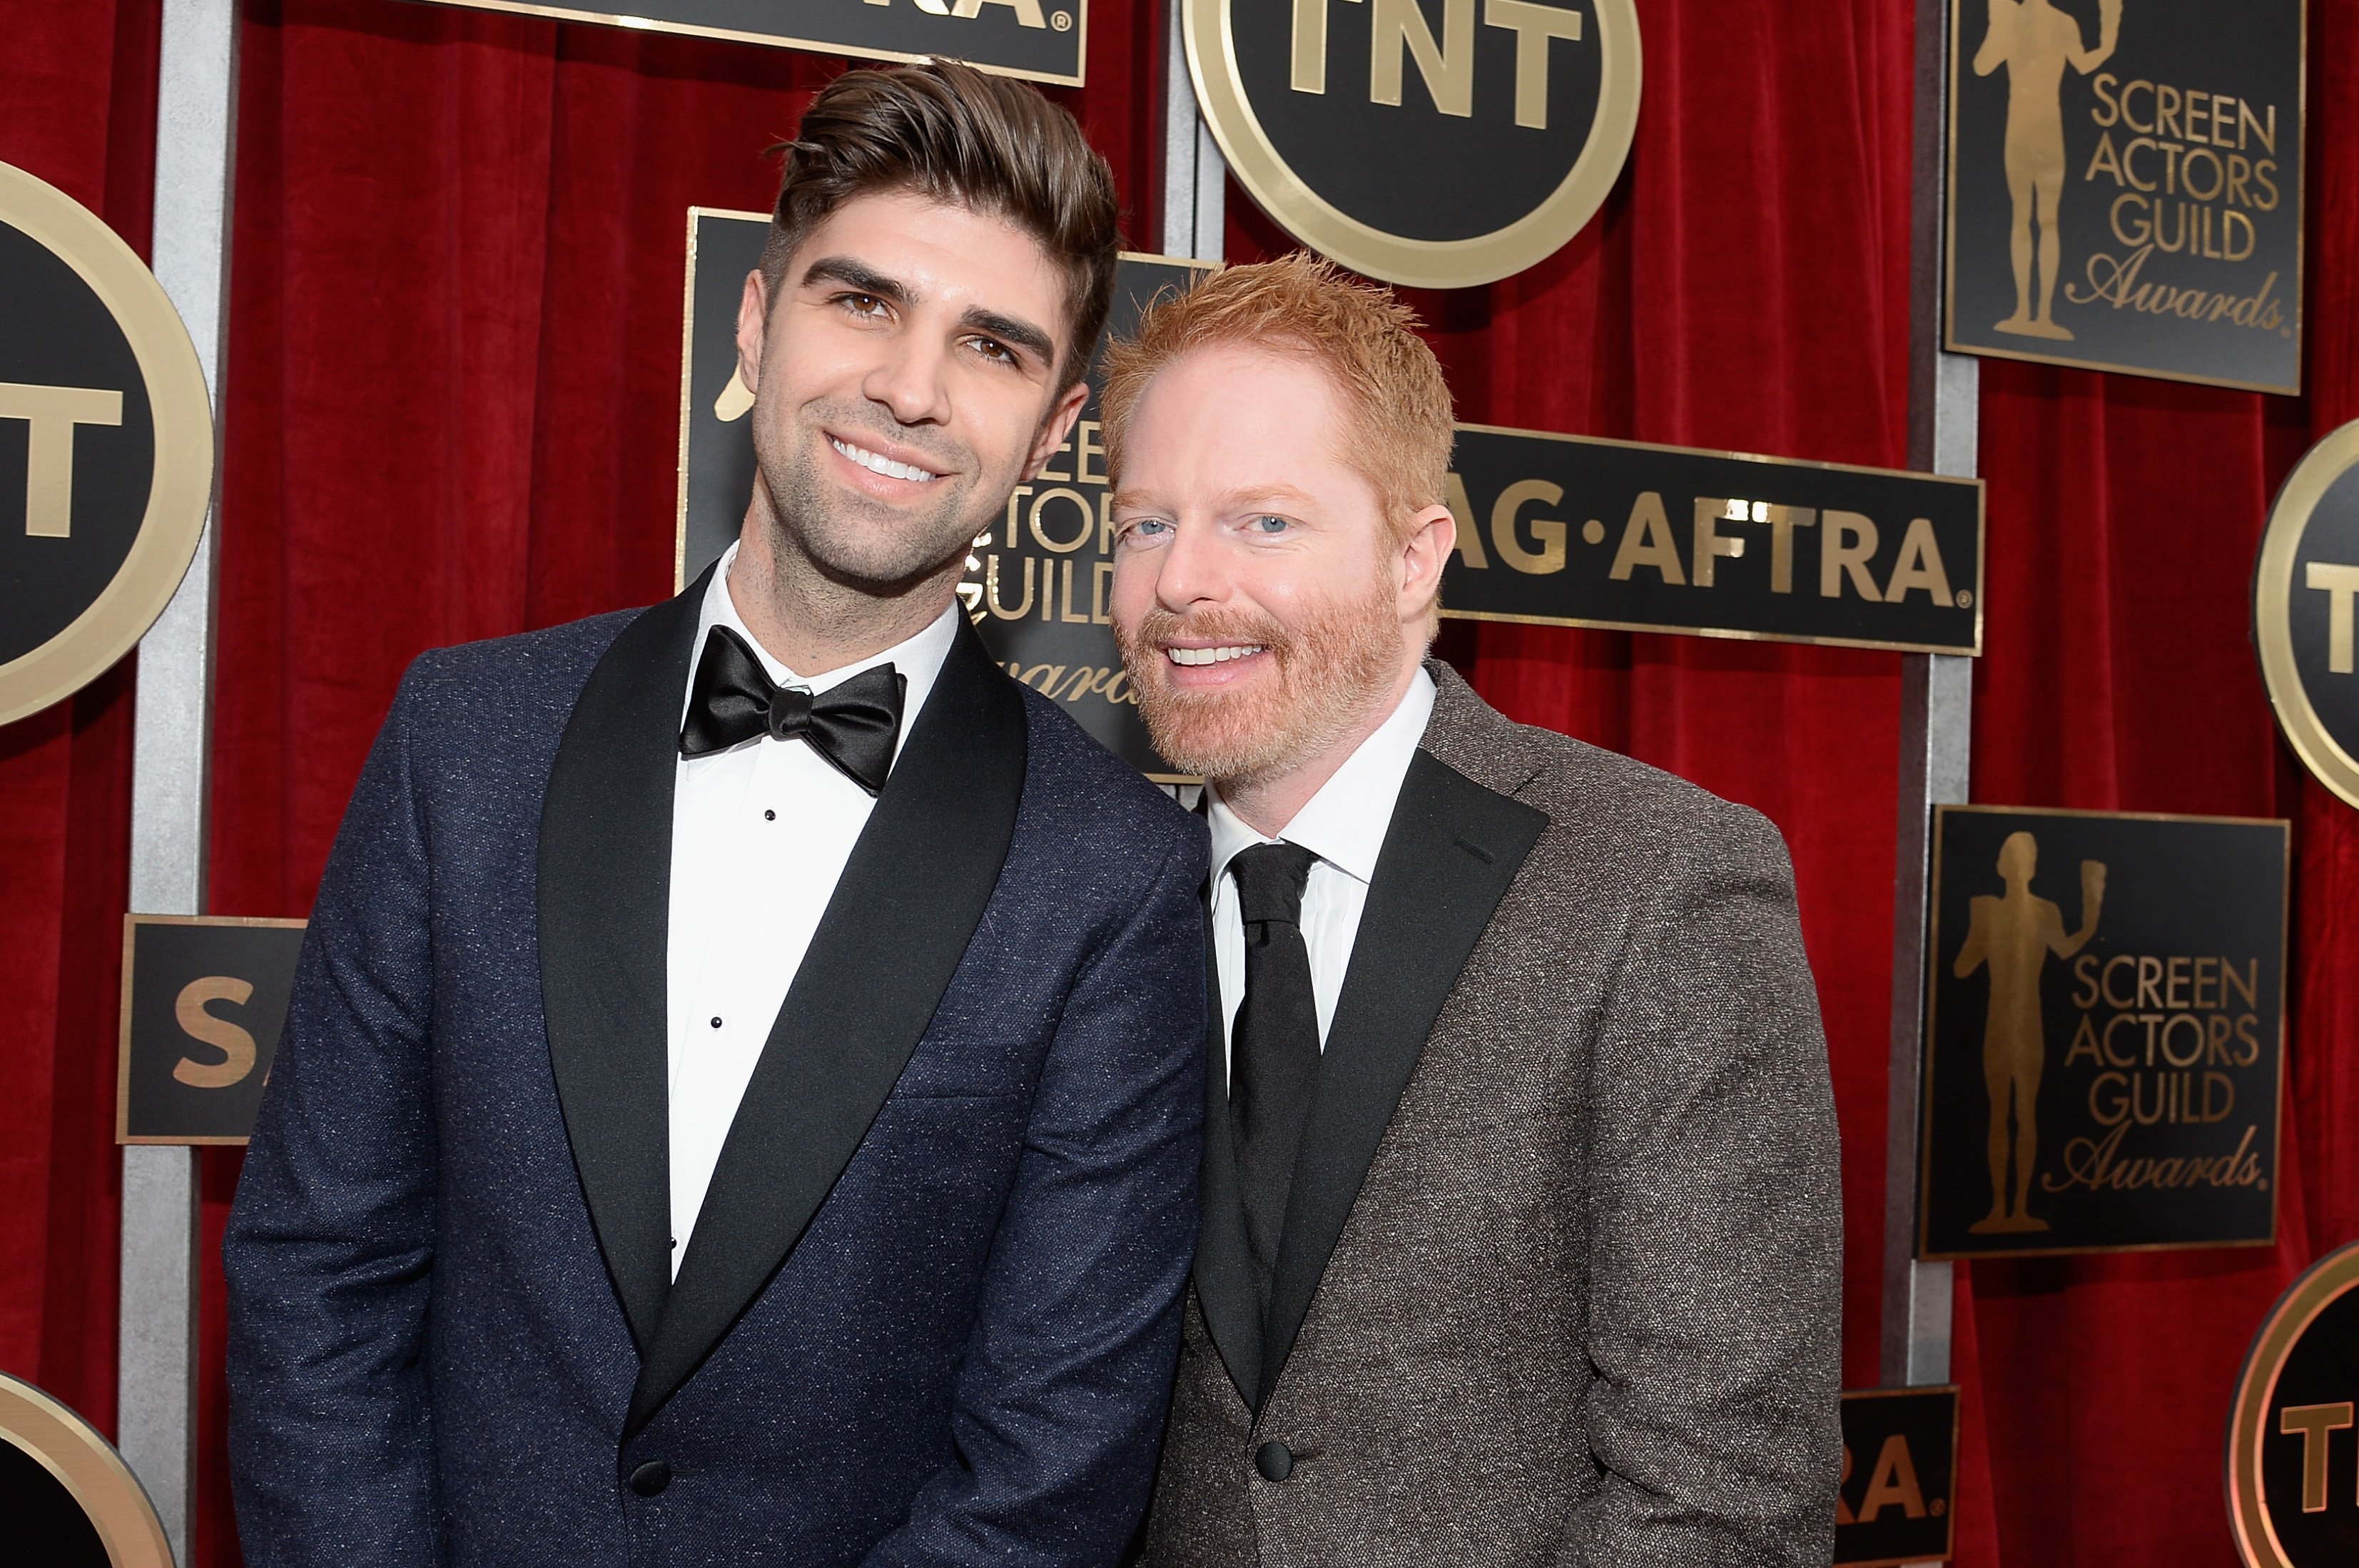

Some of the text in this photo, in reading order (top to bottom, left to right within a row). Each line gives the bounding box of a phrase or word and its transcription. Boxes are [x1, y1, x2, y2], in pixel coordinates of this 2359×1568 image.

[2091, 73, 2276, 156] SCREEN
[2085, 131, 2280, 211] ACTORS
[2109, 193, 2256, 262] GUILD
[2064, 243, 2284, 331] Awards
[2071, 954, 2258, 1009] SCREEN
[173, 975, 273, 1089] S
[2064, 1013, 2260, 1068] ACTORS
[2089, 1071, 2235, 1126] GUILD
[2041, 1119, 2261, 1193] Awards
[2281, 1401, 2359, 1514] T
